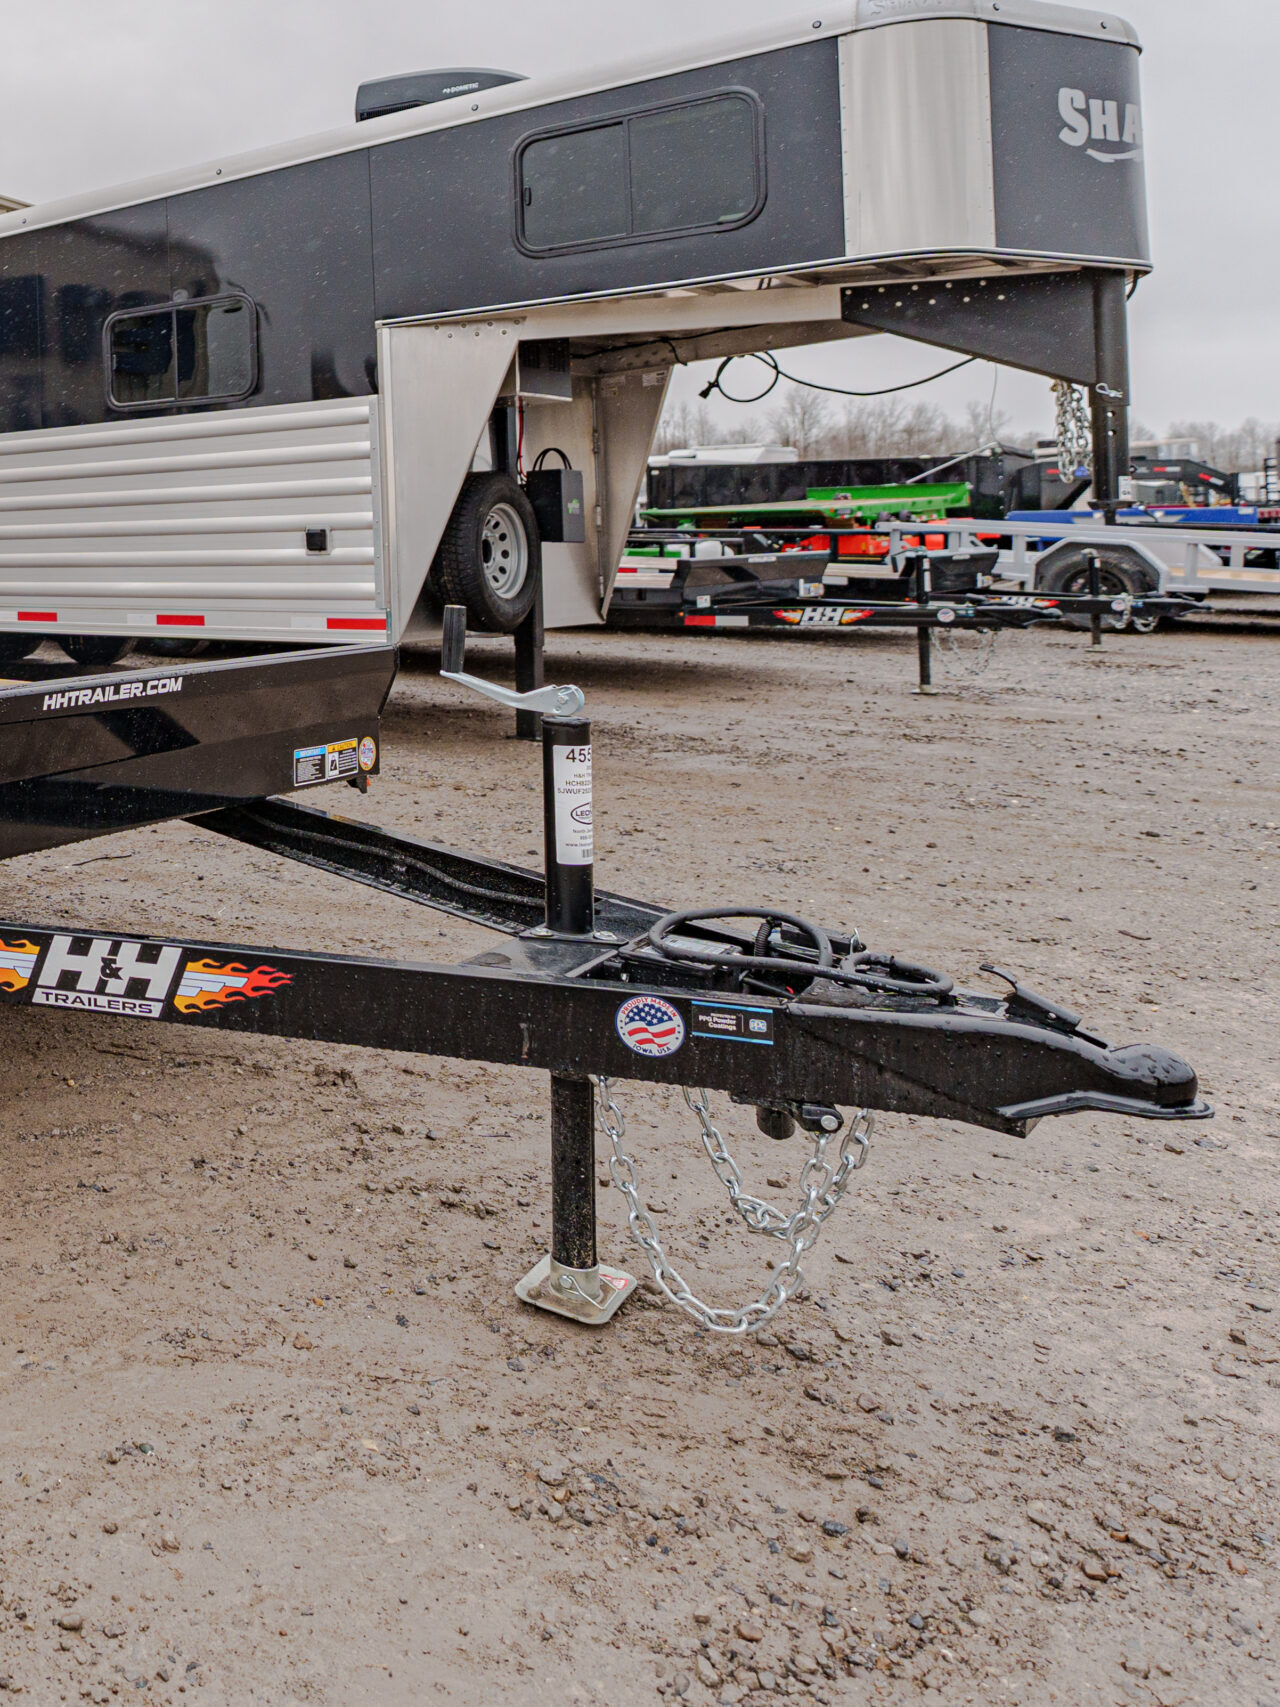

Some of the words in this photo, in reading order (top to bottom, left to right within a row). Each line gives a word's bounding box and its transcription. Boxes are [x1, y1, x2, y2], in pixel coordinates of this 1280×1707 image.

[42, 676, 184, 711] HHTRAILER.COM
[37, 935, 183, 1000] H&H
[41, 990, 153, 1014] TRAILERS
[621, 996, 649, 1016] PROUDLY
[649, 997, 671, 1010] MADE
[669, 1006, 678, 1018] IN
[708, 1022, 737, 1031] Coatings
[713, 1016, 737, 1025] Powder
[657, 1046, 672, 1055] USA
